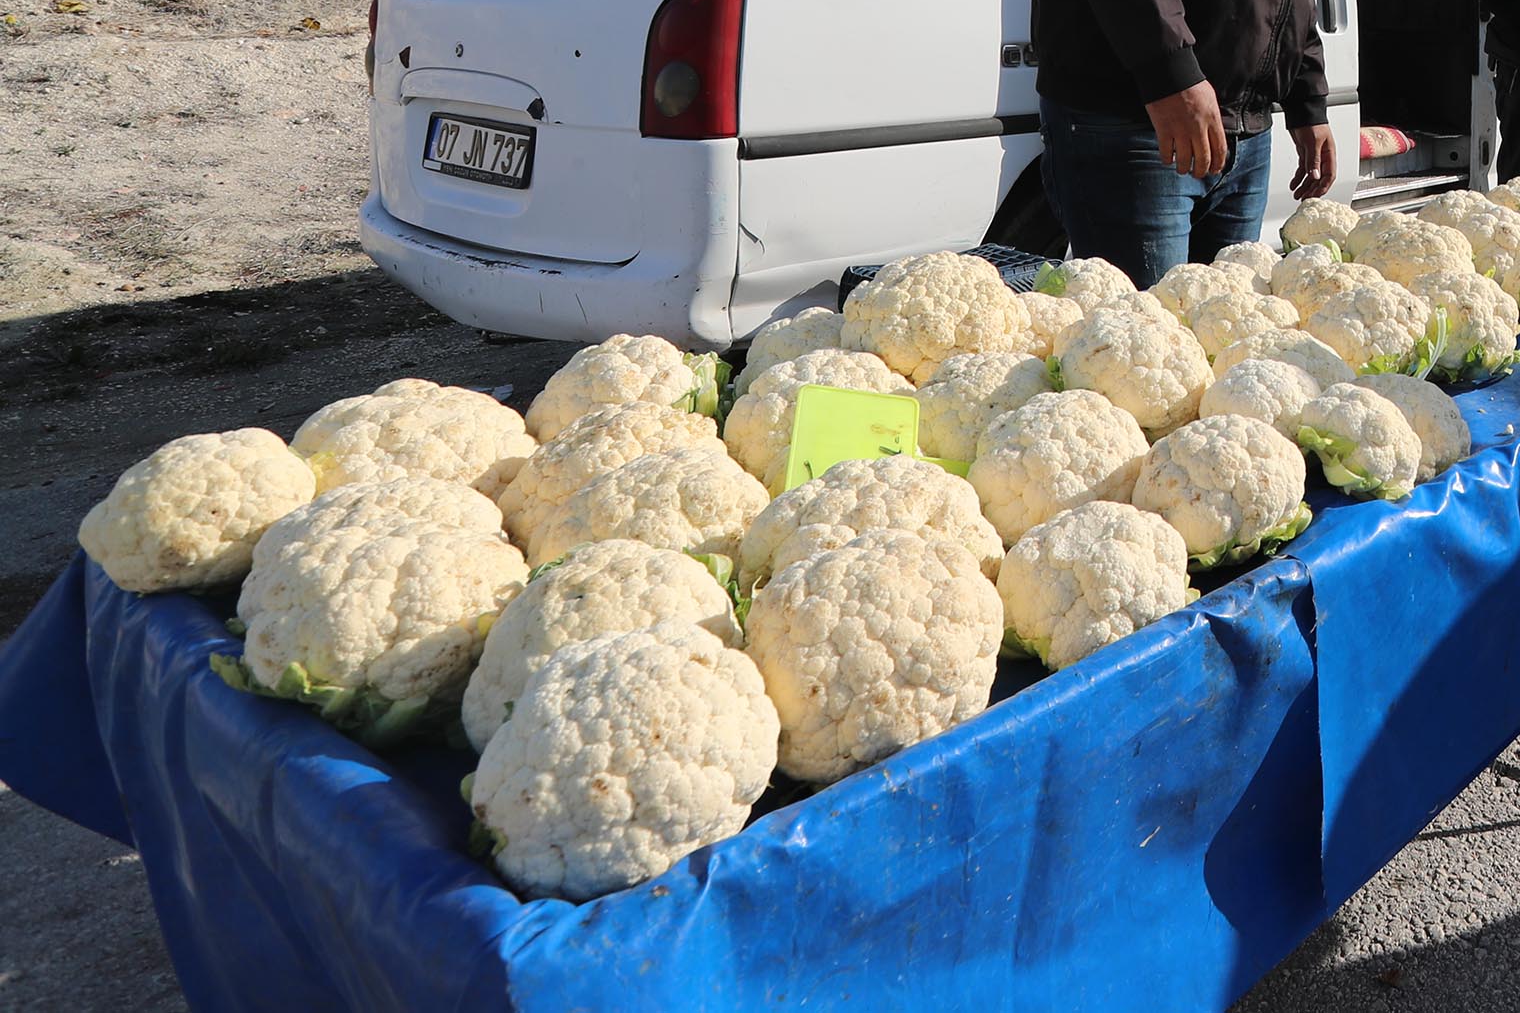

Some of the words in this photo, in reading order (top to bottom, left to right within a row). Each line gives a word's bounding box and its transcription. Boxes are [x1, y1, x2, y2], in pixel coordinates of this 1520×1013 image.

[437, 123, 460, 160] 07
[463, 129, 488, 168] JN
[490, 133, 529, 177] 737
